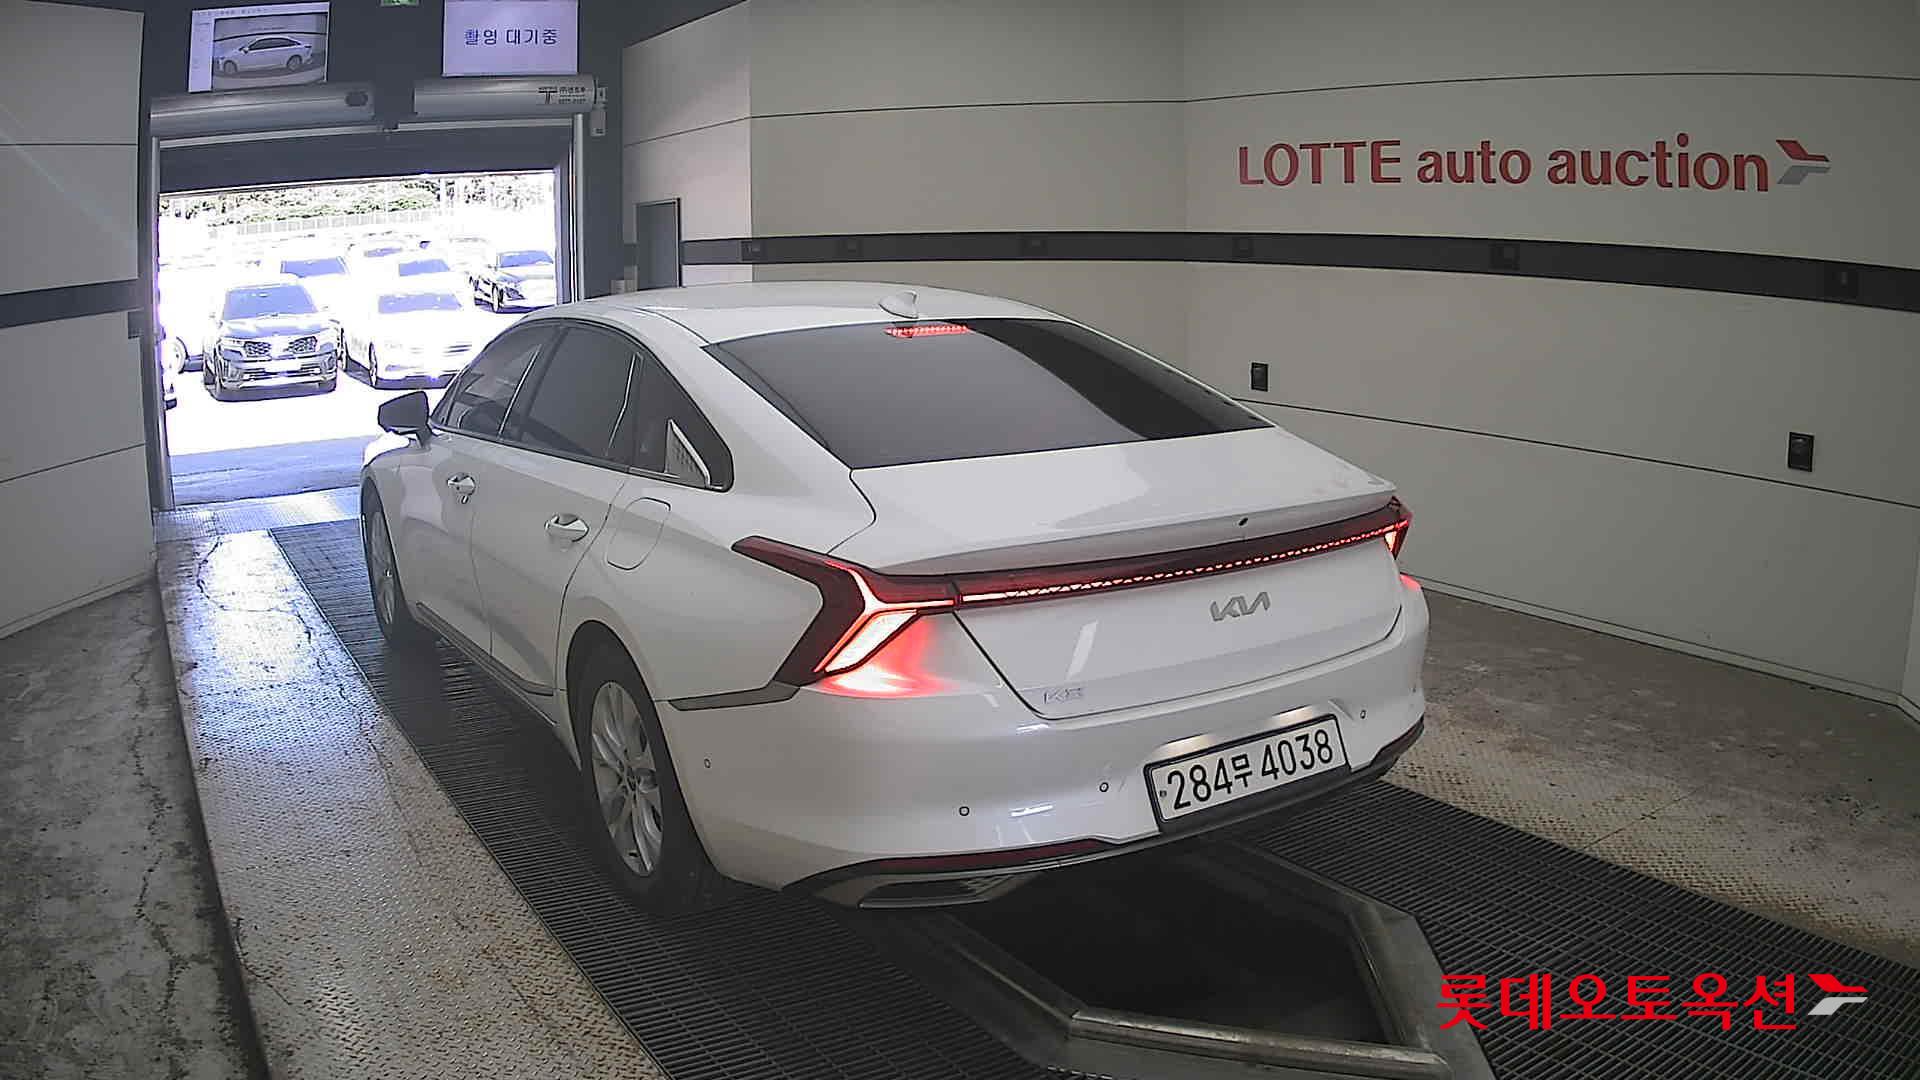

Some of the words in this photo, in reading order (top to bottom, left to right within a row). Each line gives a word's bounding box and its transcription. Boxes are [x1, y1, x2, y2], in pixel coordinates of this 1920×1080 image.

[506, 28, 557, 46] 대기중
[1239, 140, 1400, 186] LOTTE
[1417, 140, 1532, 186] auto
[1548, 133, 1769, 192] auction
[1210, 591, 1270, 622] KIA
[1167, 753, 1253, 810] 284무
[1261, 729, 1333, 780] 4038
